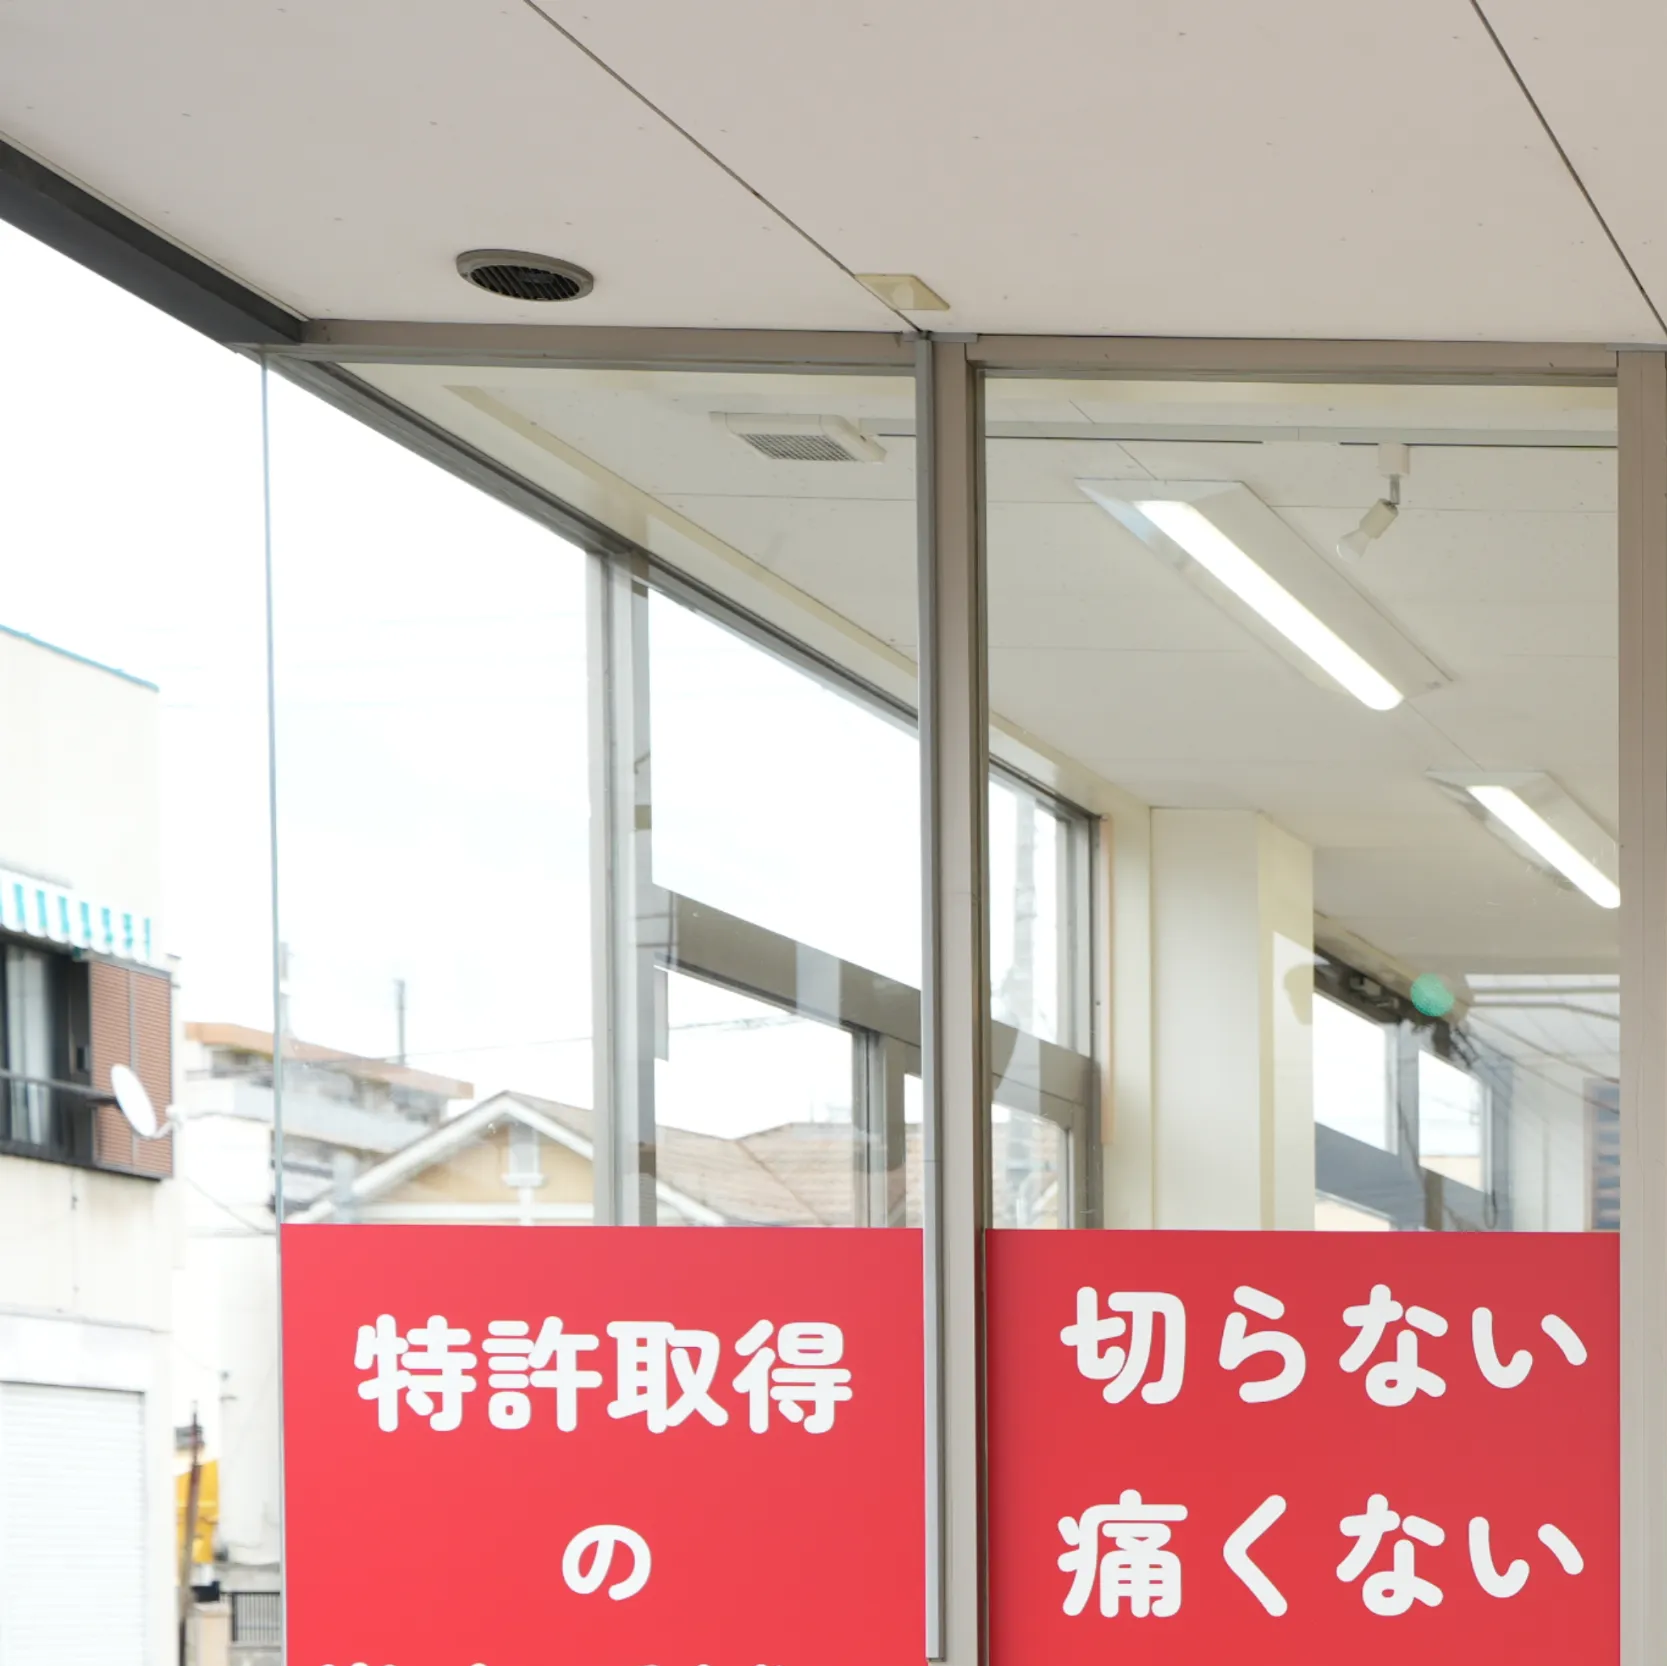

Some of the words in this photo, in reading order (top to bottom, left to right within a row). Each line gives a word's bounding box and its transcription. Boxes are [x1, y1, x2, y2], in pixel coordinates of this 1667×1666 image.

[353, 1313, 854, 1435] 特許取得
[1059, 1283, 1588, 1408] 切らない
[561, 1523, 653, 1602] の
[1056, 1488, 1585, 1619] 痛くない
